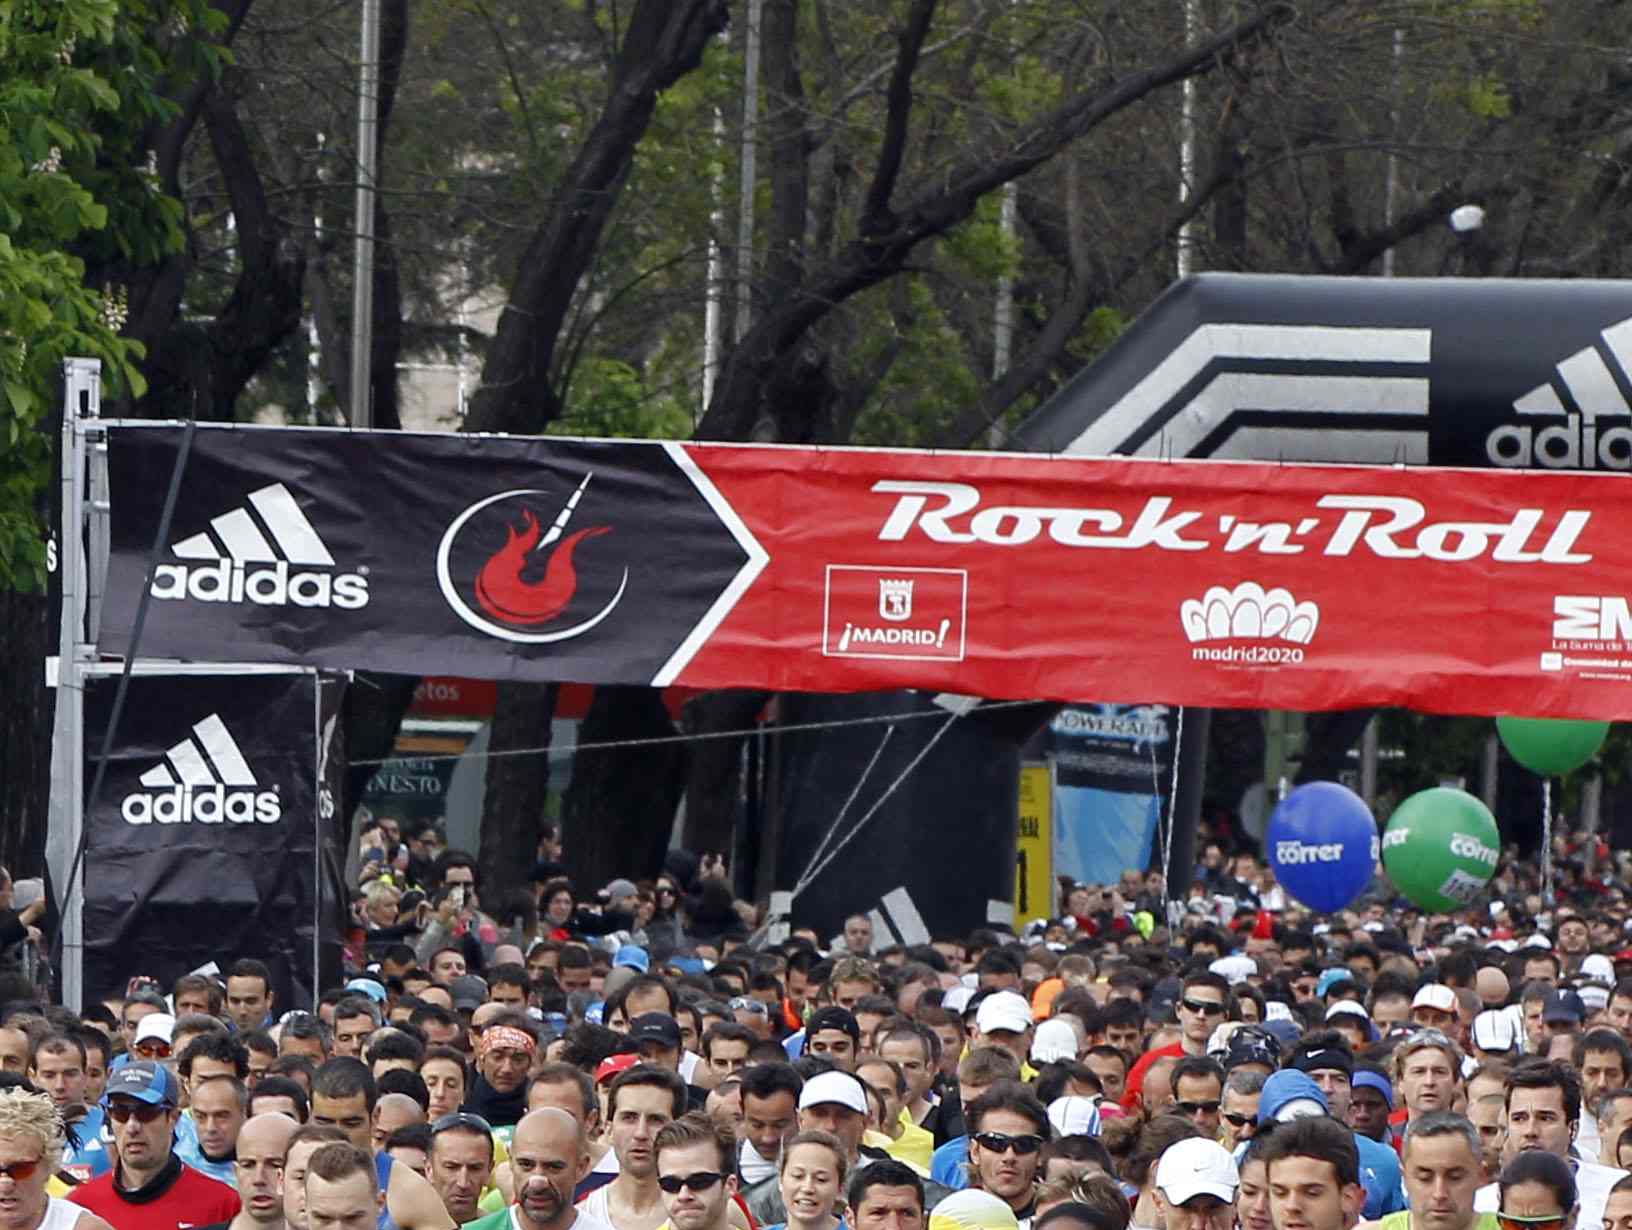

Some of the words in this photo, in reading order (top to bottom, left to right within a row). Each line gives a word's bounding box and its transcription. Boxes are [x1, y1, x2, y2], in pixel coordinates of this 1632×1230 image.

[146, 558, 369, 609] adidas
[839, 619, 950, 651] ¡MADRID!
[1192, 646, 1304, 663] madrid2020
[121, 783, 281, 824] adidas
